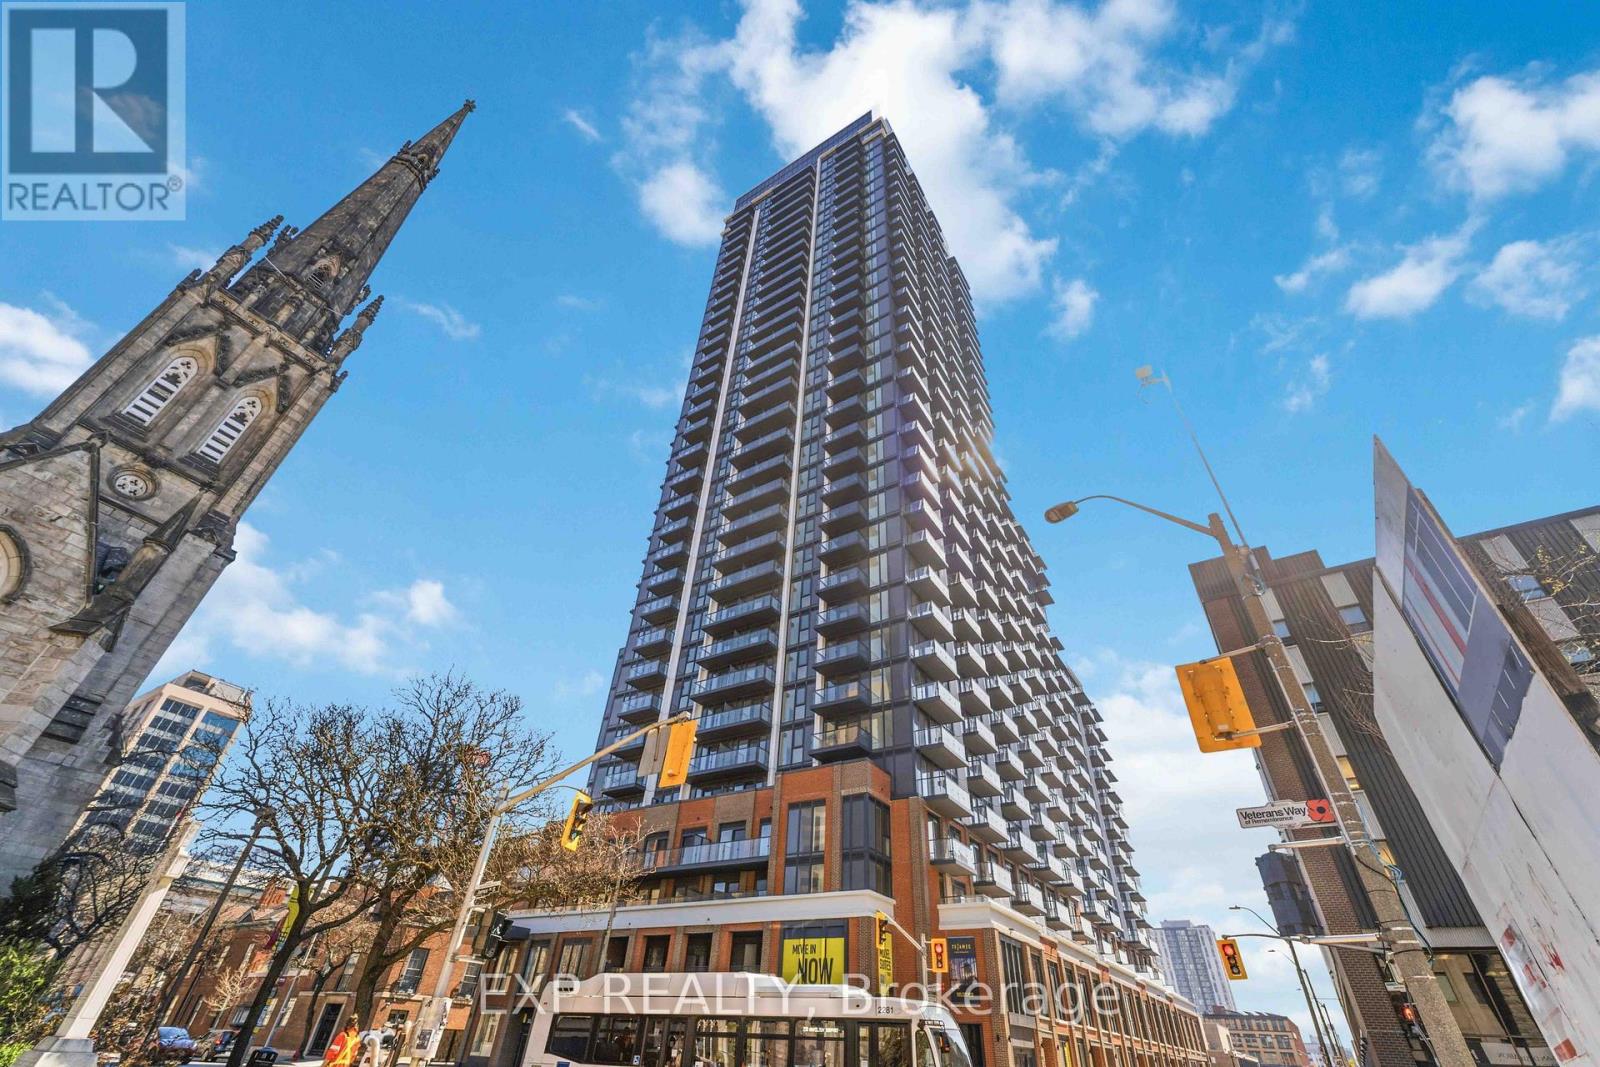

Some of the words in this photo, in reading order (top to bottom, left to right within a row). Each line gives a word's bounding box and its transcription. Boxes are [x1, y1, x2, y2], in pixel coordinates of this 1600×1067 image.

[1240, 809, 1284, 820] Veterans
[1284, 806, 1306, 817] Way
[792, 944, 809, 955] MOVE
[810, 944, 817, 954] IN
[797, 957, 833, 985] NOW
